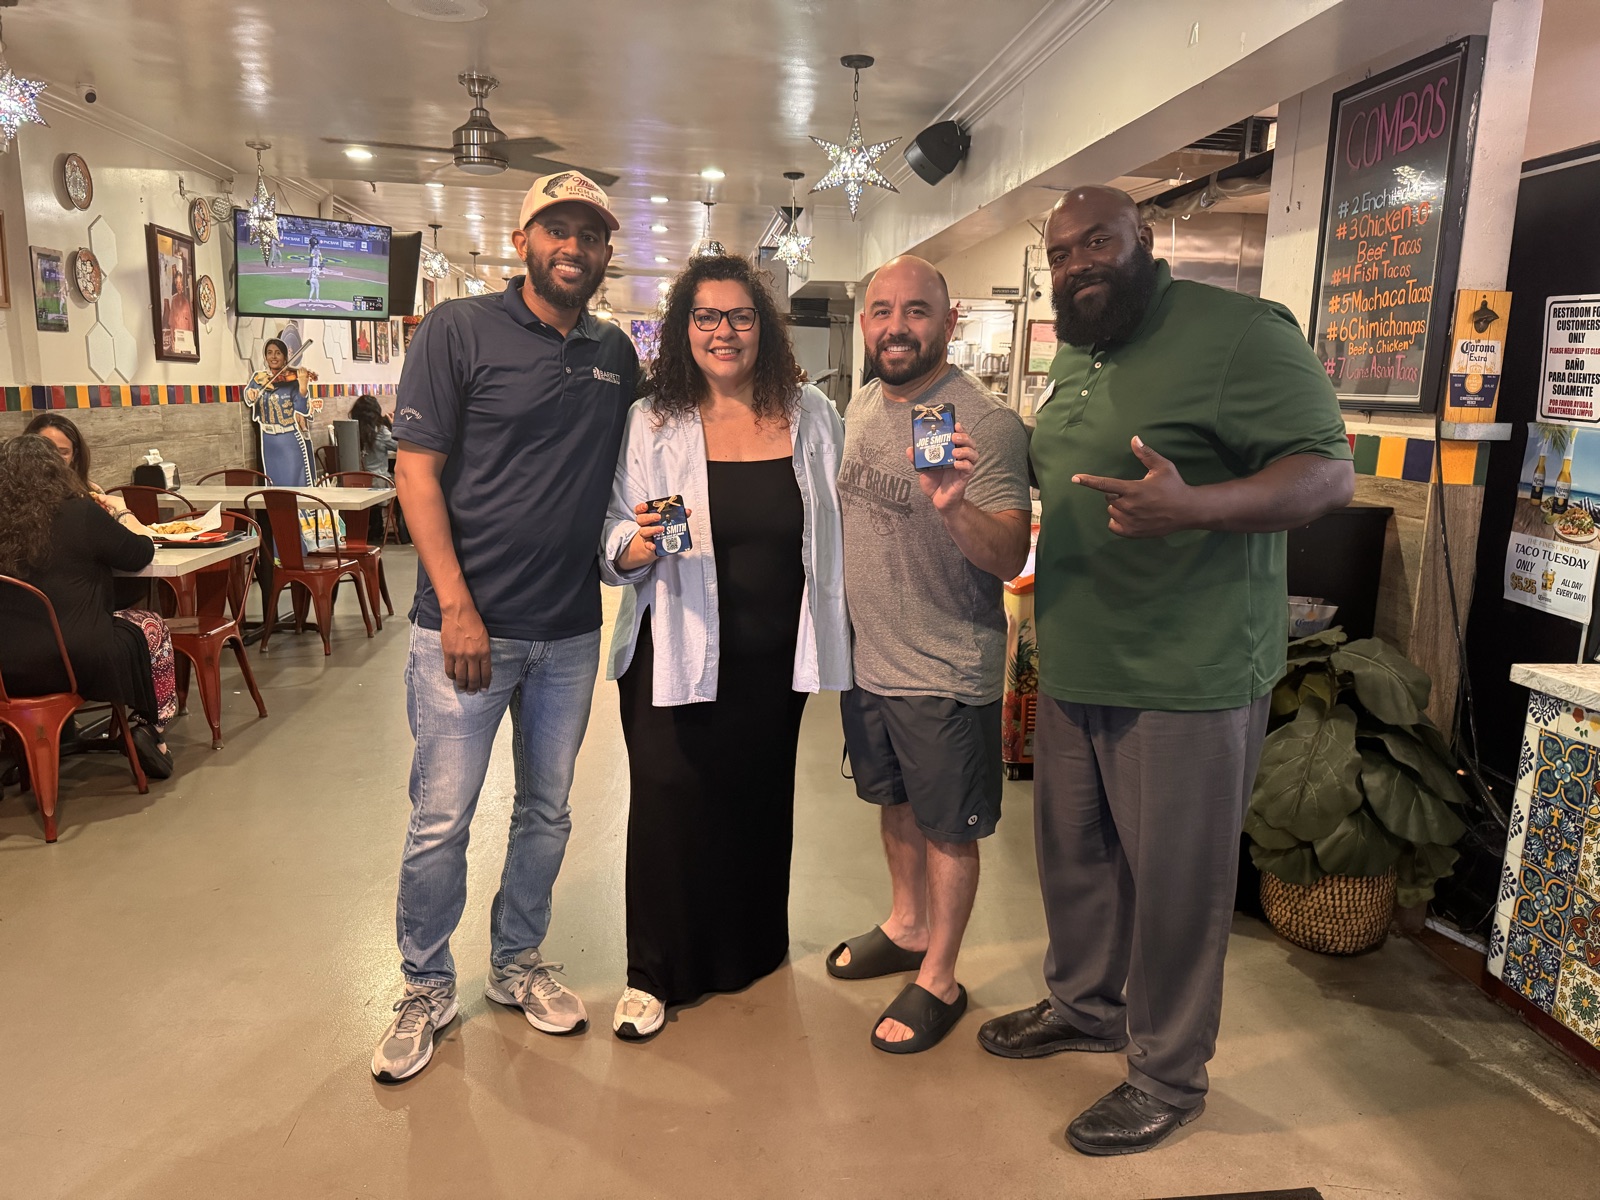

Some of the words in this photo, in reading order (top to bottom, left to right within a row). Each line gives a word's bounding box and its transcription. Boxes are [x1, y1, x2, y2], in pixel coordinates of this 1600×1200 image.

[1346, 76, 1449, 170] COMBOS
[1360, 204, 1412, 238] Chicken
[1357, 240, 1388, 263] Beef
[1390, 235, 1422, 257] Tacos
[1353, 262, 1379, 283] Fish
[1381, 260, 1411, 279] Tacos
[1351, 286, 1406, 313] Machaca
[1406, 279, 1433, 305] Tacos
[1552, 306, 1591, 318] RESTROOM
[1348, 311, 1426, 344] Chimichangas
[1557, 319, 1600, 331] CUSTOMERS
[1568, 332, 1586, 344] ONLY
[1348, 341, 1368, 356] Beef
[1376, 339, 1409, 353] Chicken
[1460, 341, 1495, 354] Corona
[1469, 353, 1487, 362] Extra
[1565, 358, 1585, 371] BAÑO
[1548, 371, 1566, 382] PARA
[1567, 372, 1600, 385] CLIENTES
[1552, 384, 1594, 397] SOLAMENTE
[916, 437, 929, 448] JOE
[930, 432, 952, 445] SMITH
[866, 467, 912, 504] BRAND
[666, 523, 687, 535] SMITH
[1515, 543, 1540, 557] TACO
[1542, 549, 1590, 570] TUESDAY
[1516, 558, 1536, 573] ONLY
[1561, 578, 1571, 587] ALL
[1571, 581, 1583, 590] DAY
[1556, 588, 1573, 599] EVERY
